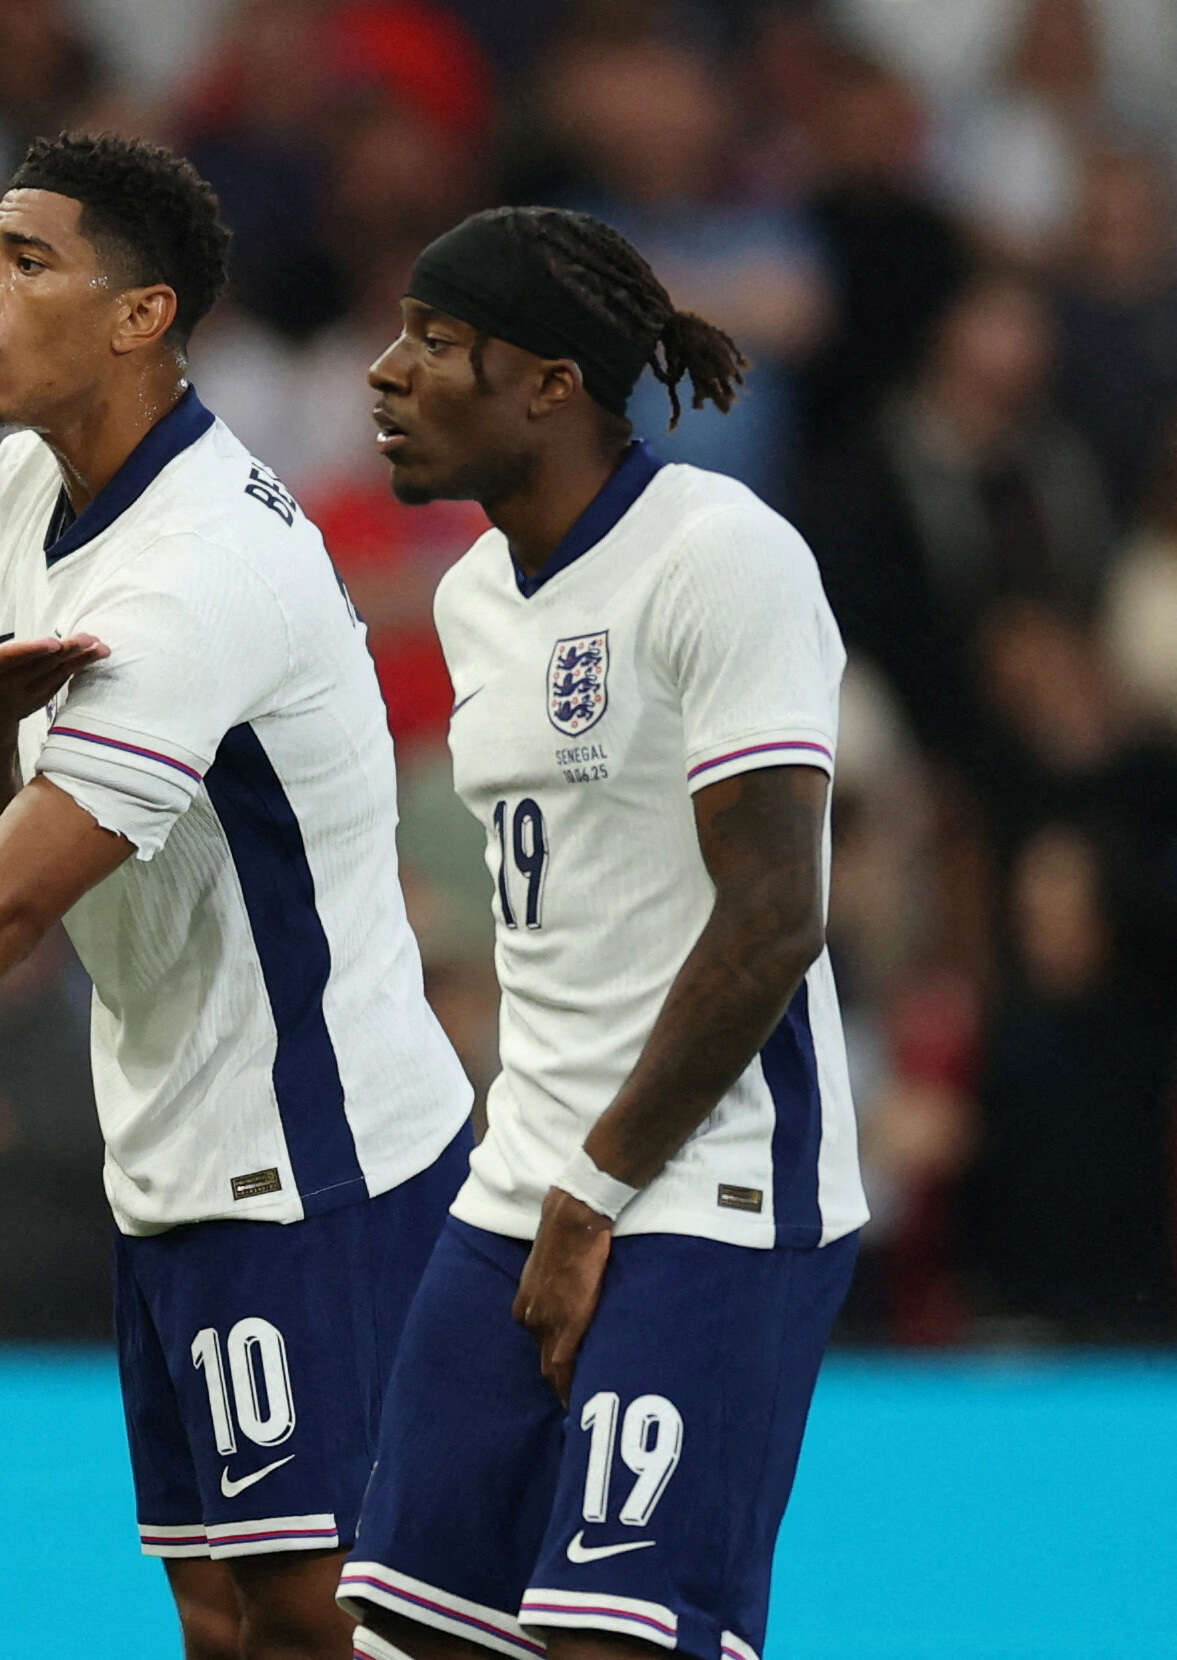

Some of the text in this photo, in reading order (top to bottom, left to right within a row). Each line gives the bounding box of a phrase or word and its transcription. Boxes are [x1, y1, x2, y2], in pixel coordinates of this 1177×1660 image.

[244, 462, 297, 528] BE
[555, 744, 608, 765] SENEGAL
[493, 798, 549, 930] 19
[191, 1317, 296, 1456] 10
[581, 1391, 684, 1527] 19
